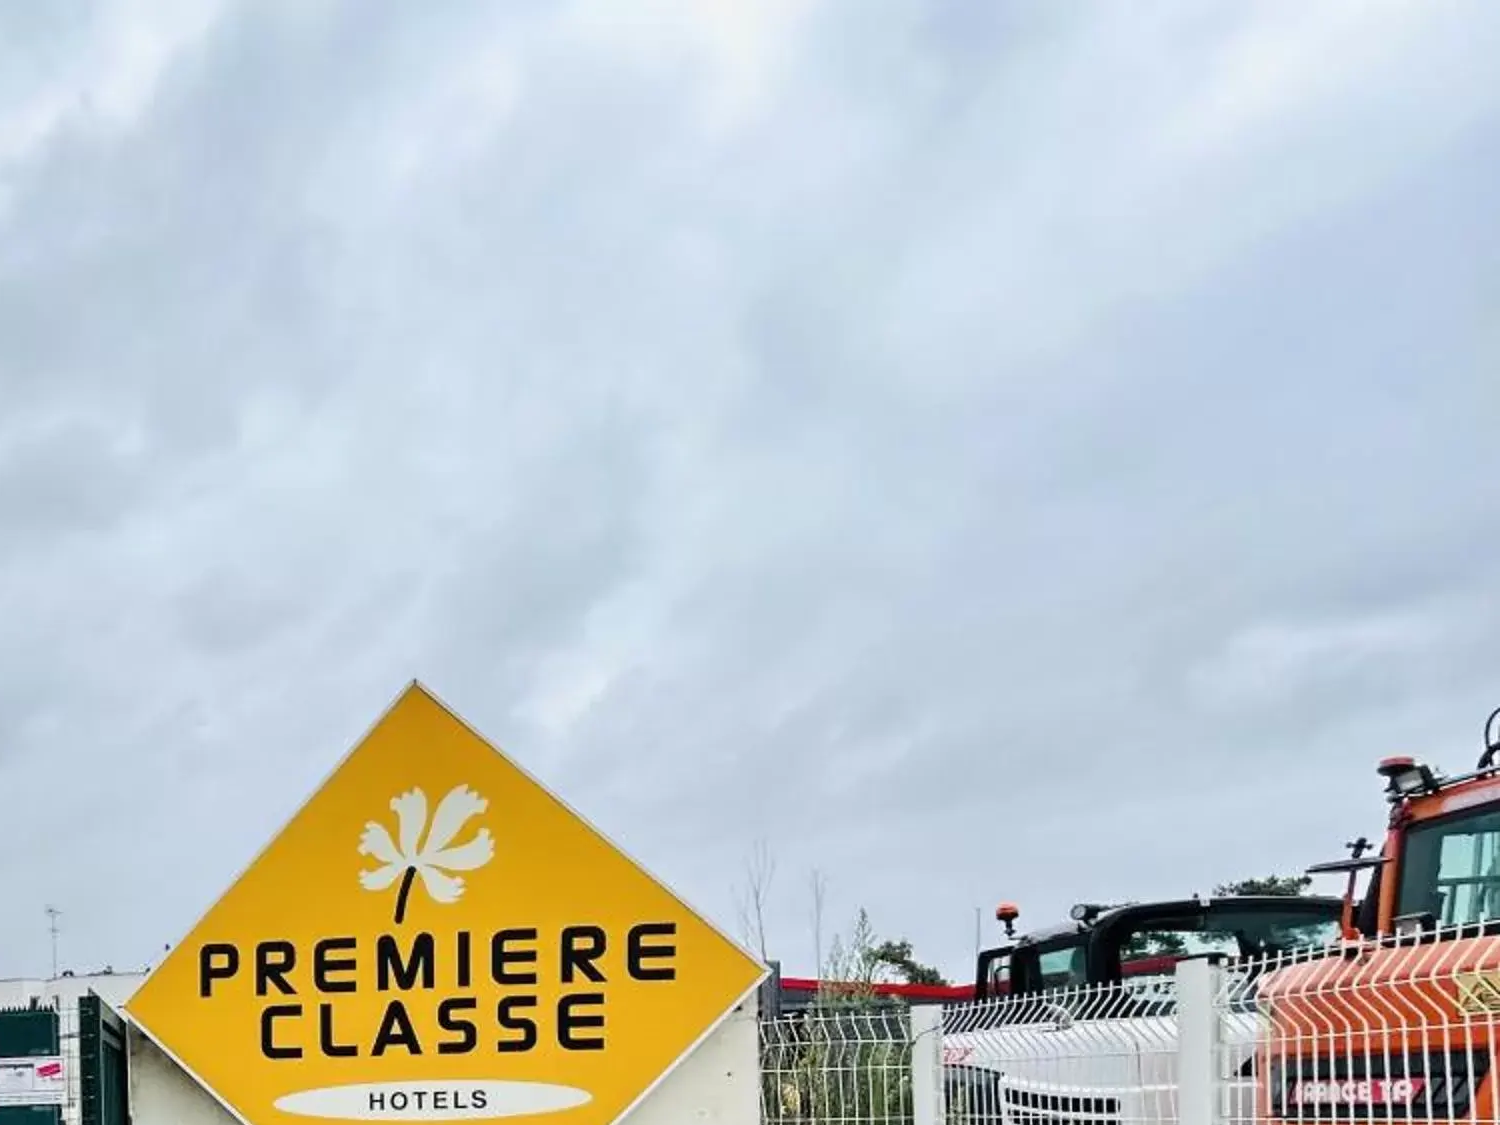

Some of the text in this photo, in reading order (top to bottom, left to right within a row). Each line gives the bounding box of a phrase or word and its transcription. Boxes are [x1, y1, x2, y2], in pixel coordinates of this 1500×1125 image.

[199, 922, 677, 998] PREMIERE
[260, 992, 605, 1060] CLASSE
[369, 1090, 487, 1111] HOTELS
